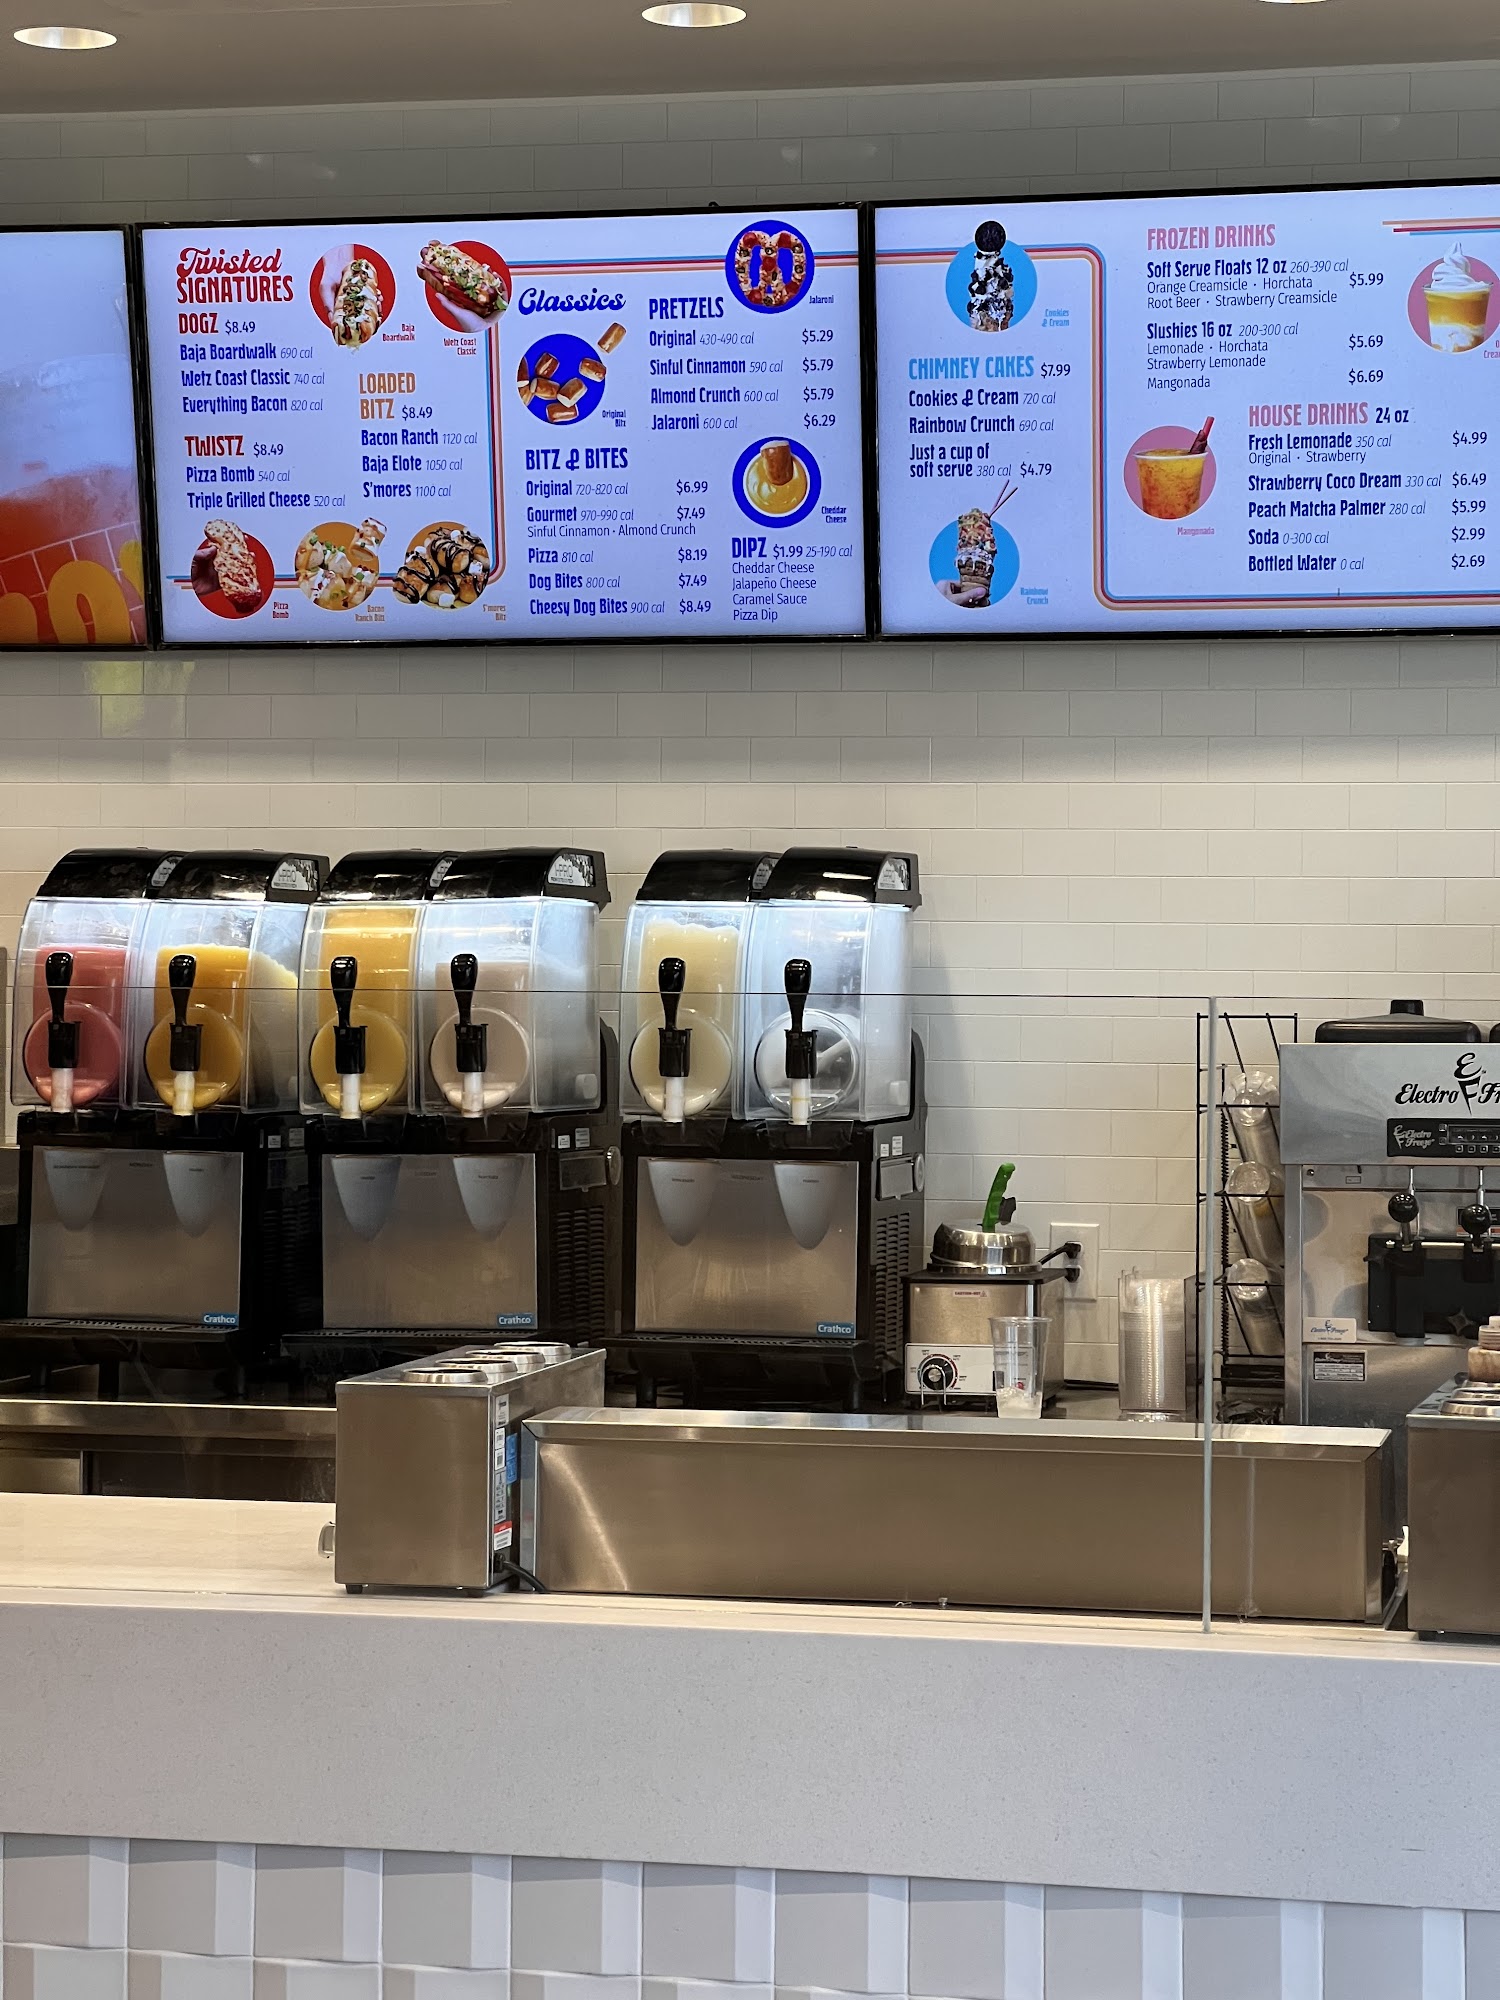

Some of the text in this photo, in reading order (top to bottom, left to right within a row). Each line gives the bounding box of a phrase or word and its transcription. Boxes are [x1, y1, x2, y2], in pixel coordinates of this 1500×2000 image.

[1148, 224, 1275, 250] FROZEN DRINKS
[177, 248, 282, 277] Twisted
[1147, 258, 1286, 278] Soft Serve Floats 12 oz
[1148, 276, 1312, 295] Orange Creamsicle Horchata
[1350, 272, 1383, 288] $5.99
[177, 276, 293, 303] SIGNATURES
[518, 288, 626, 315] Classics
[809, 295, 833, 303] Jalaroni
[1148, 290, 1337, 308] Root Beer Strawberry Creamsicle
[649, 297, 724, 319] PRETZELS
[179, 313, 255, 335] DOGZ $8.49
[402, 324, 414, 332] Baja
[1147, 322, 1232, 339] Slushies 16 oz
[383, 333, 415, 341] Boardwalk
[444, 338, 458, 346] Wetz
[650, 330, 754, 348] Original 430-490 cal
[802, 328, 833, 345] $5.29
[1349, 334, 1383, 350] $5.69
[180, 343, 276, 362] Baja Boardwalk
[457, 347, 476, 355] Classic
[1148, 339, 1267, 354] Lemonade Horchata
[650, 358, 745, 375] Sinful Cinnamon
[803, 357, 833, 373] $5.79
[909, 356, 1070, 380] CHIMNEY CAKES $7.99
[1148, 354, 1265, 371] Strawberry Lemonade
[181, 368, 290, 386] Wetz Coast Classic
[360, 373, 415, 394] LOADED
[1148, 375, 1210, 391] Mangonada
[1349, 368, 1383, 385] $6.69
[651, 387, 740, 403] Almond Crunch
[804, 386, 833, 402] $5.79
[909, 389, 957, 406] Cookies
[978, 389, 1018, 405] Cream
[183, 396, 287, 414] Everything Bacon
[360, 398, 432, 421] BITZ $8.49
[652, 414, 699, 430] Jalaroni
[804, 413, 835, 429] $6.29
[1249, 402, 1409, 427] HOUSE DRINKS 24 oz
[910, 415, 1014, 433] Rainbow Crunch
[362, 429, 438, 445] Bacon Ranch
[1249, 432, 1352, 450] Fresh Lemonade
[1453, 430, 1487, 447] $4.99
[184, 436, 283, 458] TWISTZ $8.49
[910, 443, 989, 462] Just a cup of
[363, 455, 421, 474] Baja Elote
[526, 449, 560, 470] BITZ
[585, 448, 628, 469] BITES
[1249, 450, 1366, 466] Original Strawberry
[187, 466, 254, 482] Pizza Bomb
[910, 461, 1051, 478] soft serve $4.79
[677, 479, 708, 495] $6.99
[1249, 473, 1401, 492] Strawberry Coco Dream
[1452, 472, 1486, 488] $6.49
[363, 482, 411, 497] S'mores
[527, 480, 572, 498] Original
[187, 491, 310, 510] Triple Grilled Cheese
[1249, 500, 1386, 517] Peach Matcha Palmer
[1452, 499, 1486, 515] $5.99
[527, 507, 577, 522] Gourmet
[677, 506, 705, 521] $7.49
[822, 506, 846, 514] Cheddar
[826, 515, 846, 523] Cheese
[528, 523, 695, 537] Sinful Cinnamon Almond Crunch
[1249, 529, 1278, 544] Soda
[1452, 526, 1485, 543] $2.99
[529, 548, 558, 563] Pizza
[678, 547, 707, 563] $8.19
[732, 537, 802, 560] DIPZ $1.99
[733, 562, 814, 573] Cheddar Cheese
[1249, 555, 1336, 571] Bottled Water
[1452, 553, 1484, 570] $2.69
[529, 573, 582, 591] Dog Bites
[679, 573, 707, 589] $7.49
[733, 577, 816, 592] Jalapeño Cheese
[530, 598, 627, 616] Cheesy Dog Bites
[680, 599, 711, 614] $8.49
[733, 593, 807, 605] Caramel Sauce
[734, 609, 777, 623] Pizza Dip
[1395, 1083, 1460, 1104] Electro
[204, 1315, 236, 1323] Crathco
[499, 1316, 532, 1324] Crathco
[818, 1325, 852, 1333] Crathco
